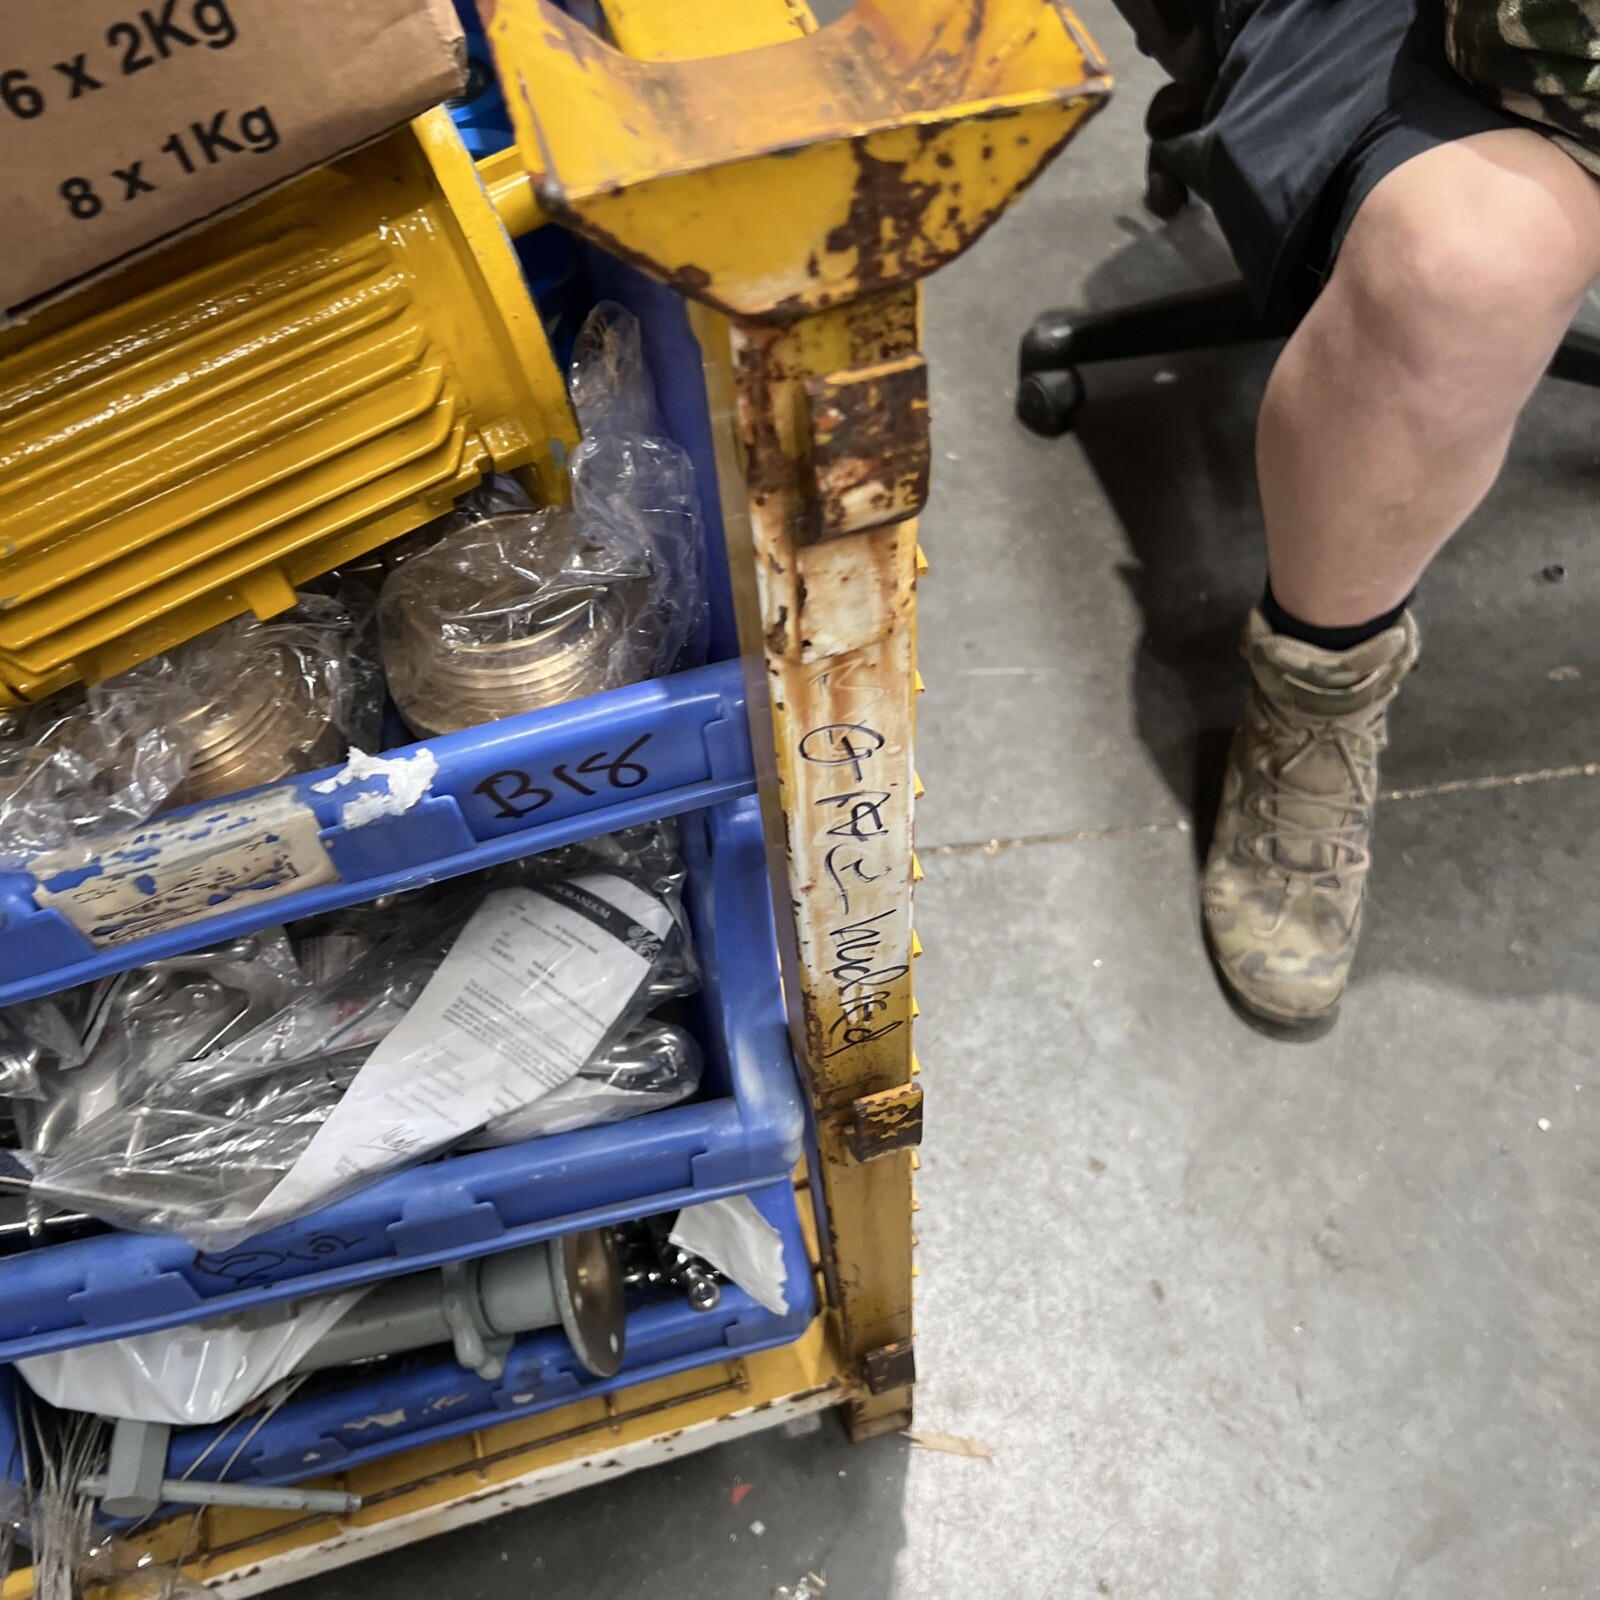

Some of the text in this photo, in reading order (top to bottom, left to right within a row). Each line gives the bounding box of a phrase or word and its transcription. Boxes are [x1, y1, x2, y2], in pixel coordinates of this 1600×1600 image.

[0, 0, 239, 120] 6 x 2Kg
[60, 105, 281, 220] 8 x 1Kg
[472, 733, 654, 819] B18
